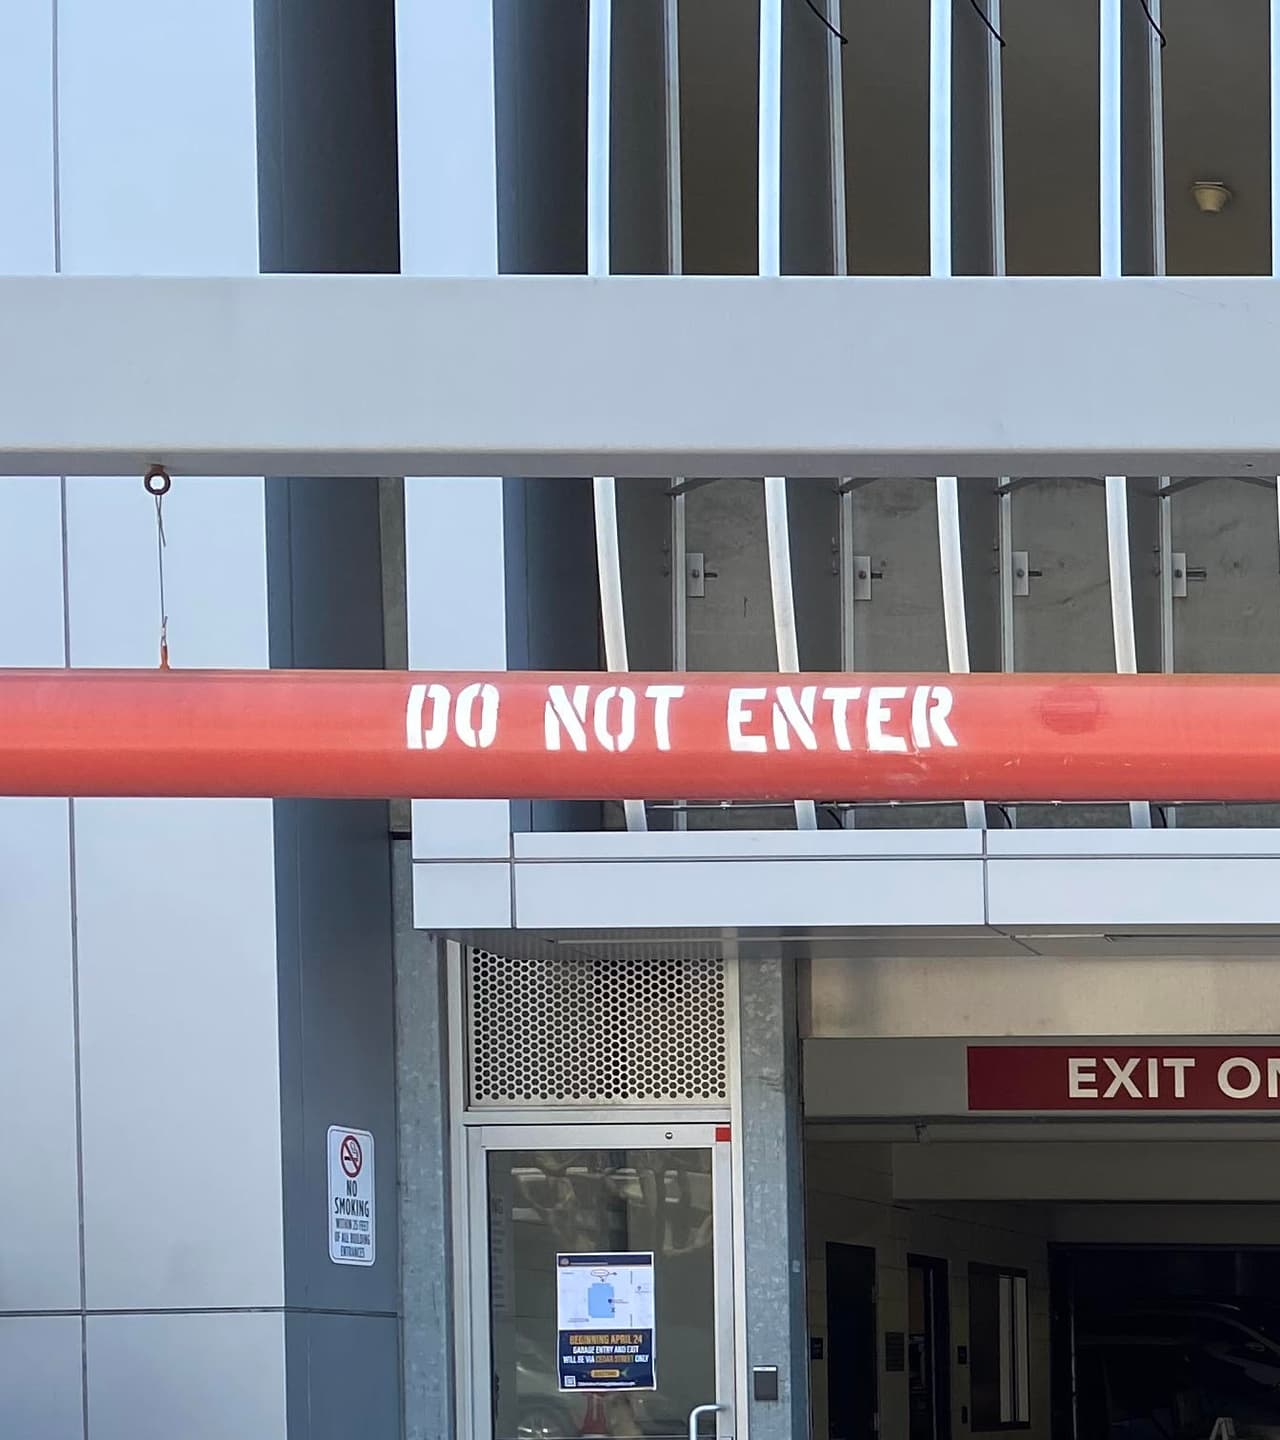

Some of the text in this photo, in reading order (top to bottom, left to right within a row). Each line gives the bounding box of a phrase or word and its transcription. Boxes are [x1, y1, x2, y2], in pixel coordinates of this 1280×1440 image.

[406, 683, 958, 752] DO NOT ENTER
[1067, 1057, 1196, 1098] EXIT
[346, 1180, 358, 1197] NO
[334, 1197, 370, 1217] SMOKING
